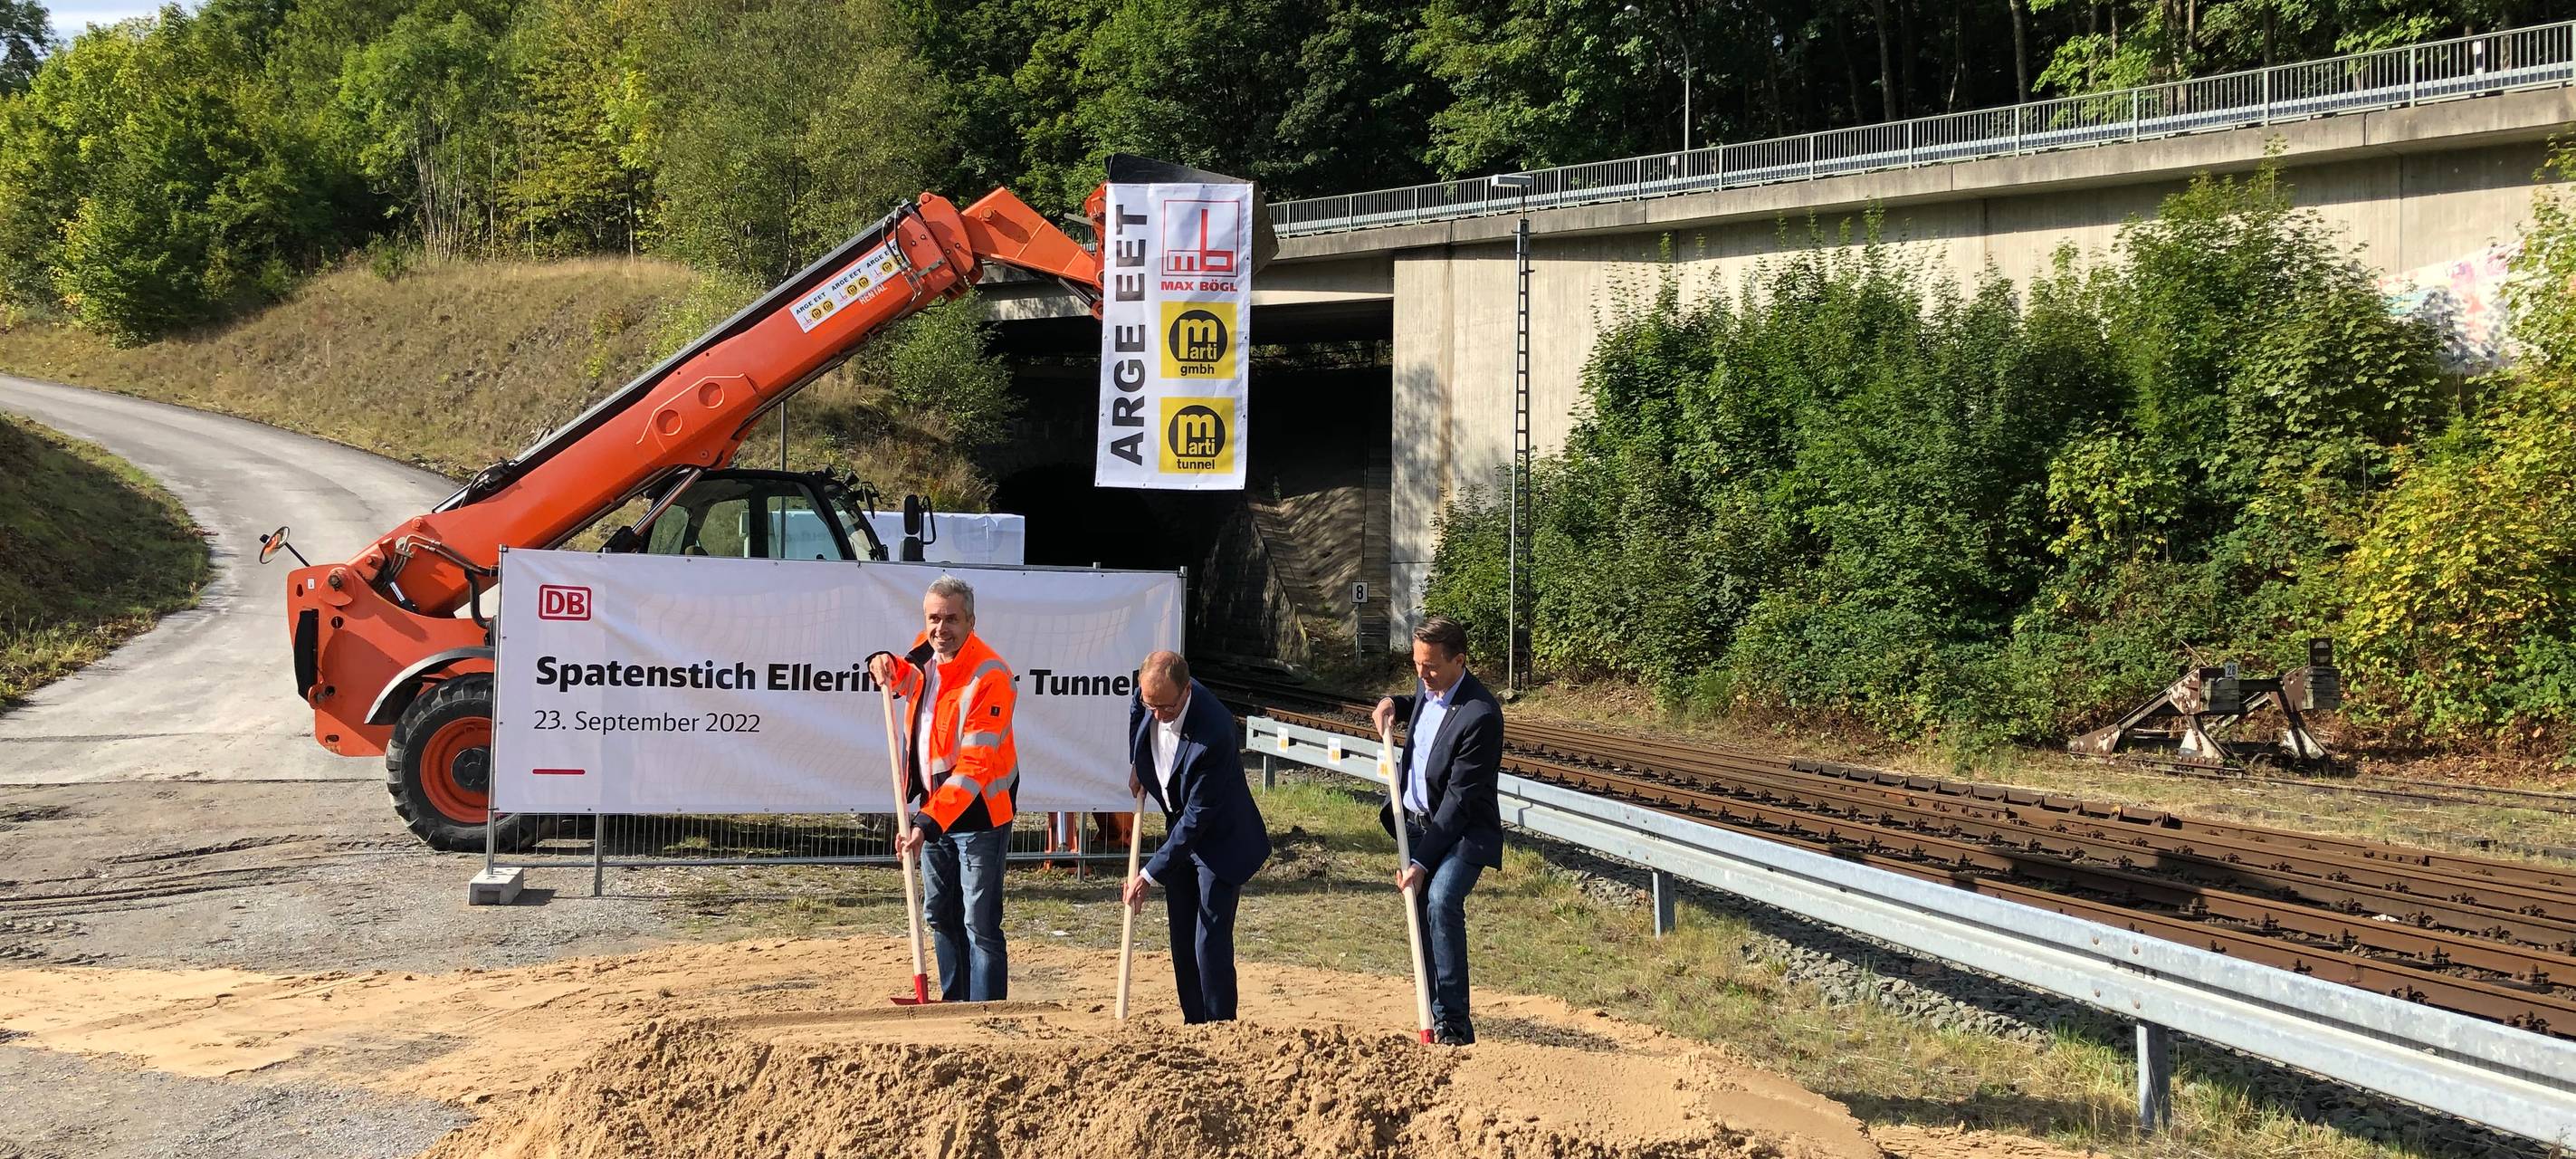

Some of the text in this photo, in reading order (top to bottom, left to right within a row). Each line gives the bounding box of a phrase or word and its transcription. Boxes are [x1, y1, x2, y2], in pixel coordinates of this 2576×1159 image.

[866, 254, 884, 270] ARGE
[883, 244, 897, 256] ET
[831, 277, 849, 292] ARGE
[849, 268, 863, 280] EET
[1160, 278, 1238, 292] MAX BÖGL
[796, 300, 814, 315] ARGE
[814, 292, 827, 304] EET
[859, 283, 889, 305] RENTAL
[1110, 204, 1149, 466] ARGE EET
[1179, 364, 1215, 377] gmbh
[1177, 458, 1216, 470] tunnel
[545, 589, 586, 616] DB
[1357, 585, 1364, 599] 8
[536, 655, 758, 693] Spatenstich
[534, 710, 761, 736] 23. September 2022
